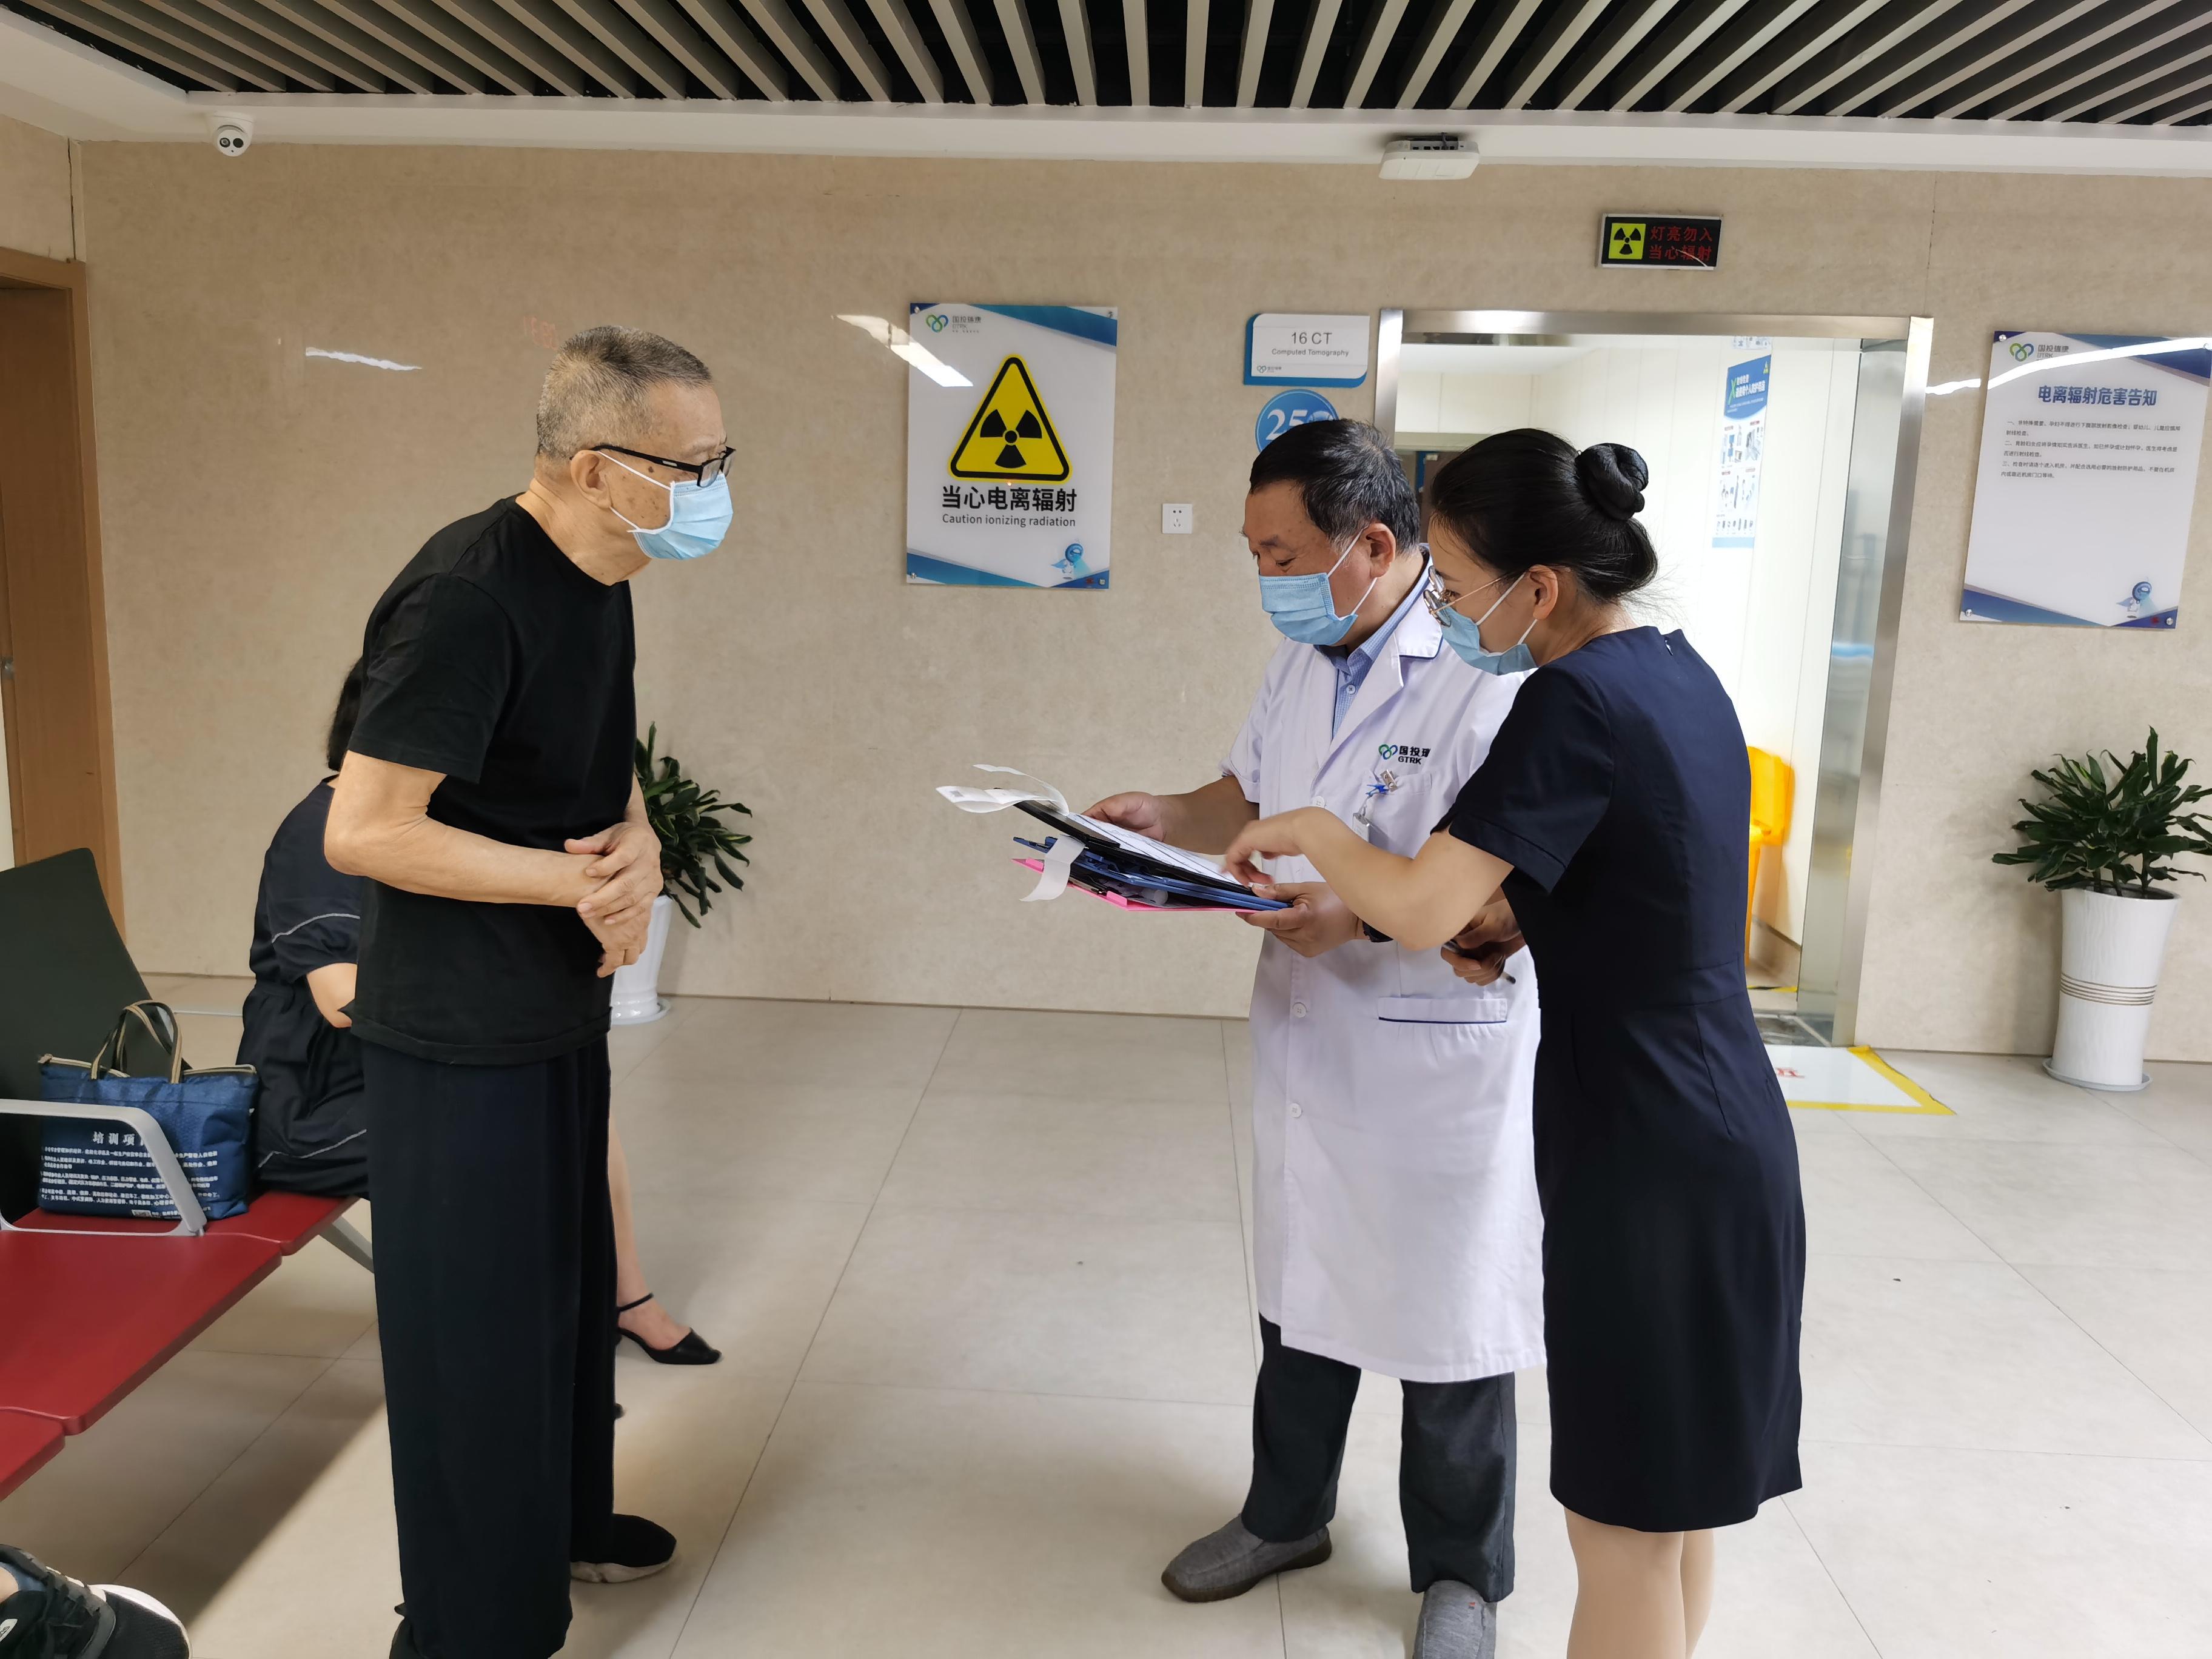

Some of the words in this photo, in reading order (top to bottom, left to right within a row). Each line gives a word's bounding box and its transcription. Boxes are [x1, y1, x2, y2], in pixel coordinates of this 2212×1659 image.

[1650, 226, 1713, 242] 灯亮勿入
[1649, 245, 1712, 261] 当心辐射
[1292, 332, 1307, 345] 16
[1311, 332, 1333, 345] CT
[2037, 385, 2157, 406] 电离辐射危害告知
[942, 485, 1078, 512] 当心电离辐射
[942, 514, 982, 525] Caution
[985, 514, 1026, 528] ionizing
[1029, 515, 1076, 527] radiation
[1398, 756, 1422, 765] GTRK
[92, 1131, 145, 1146] 培训项
